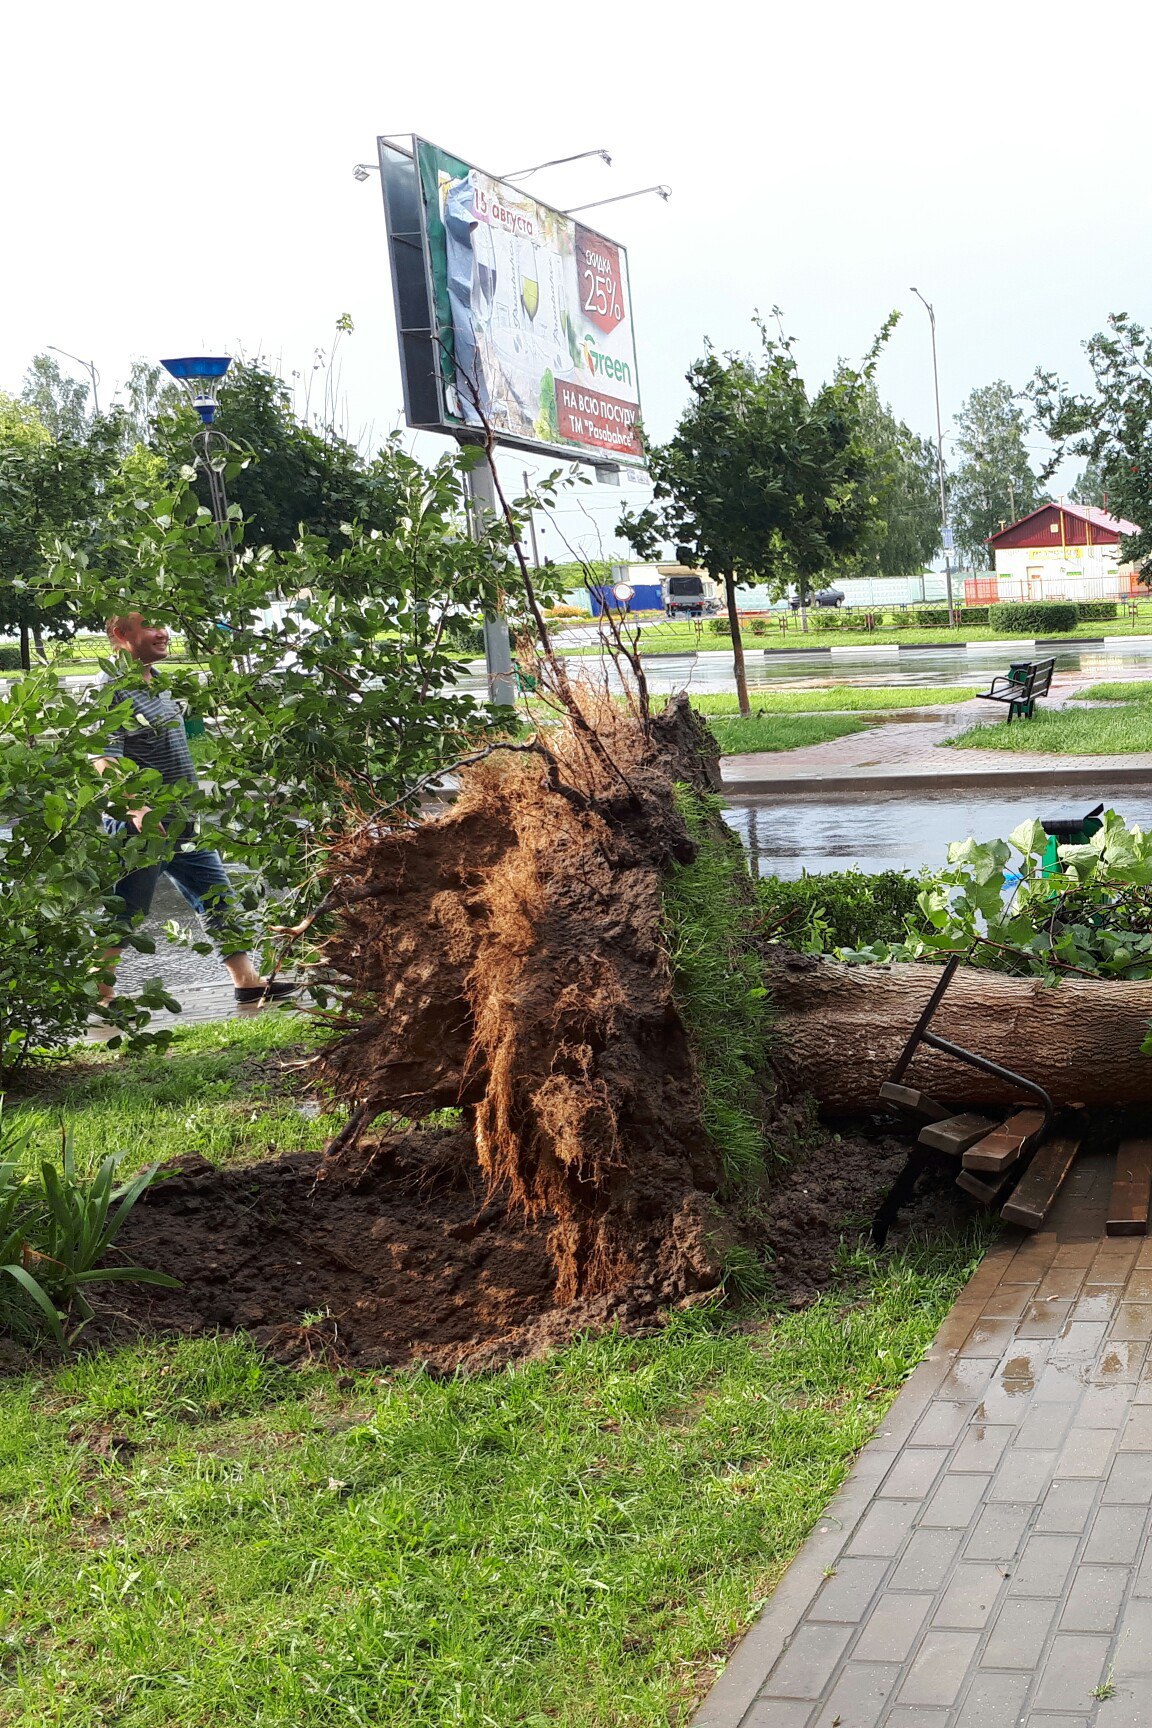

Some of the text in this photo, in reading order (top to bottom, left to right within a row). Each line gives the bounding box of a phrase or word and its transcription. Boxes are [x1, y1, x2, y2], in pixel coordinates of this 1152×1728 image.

[475, 187, 533, 235] 15 августа
[586, 250, 612, 275] СКИДКА
[584, 269, 621, 320] 25%
[584, 334, 632, 387] Green
[563, 389, 635, 427] НА ВСЮ ПОСУДУ
[569, 415, 584, 435] ТМ
